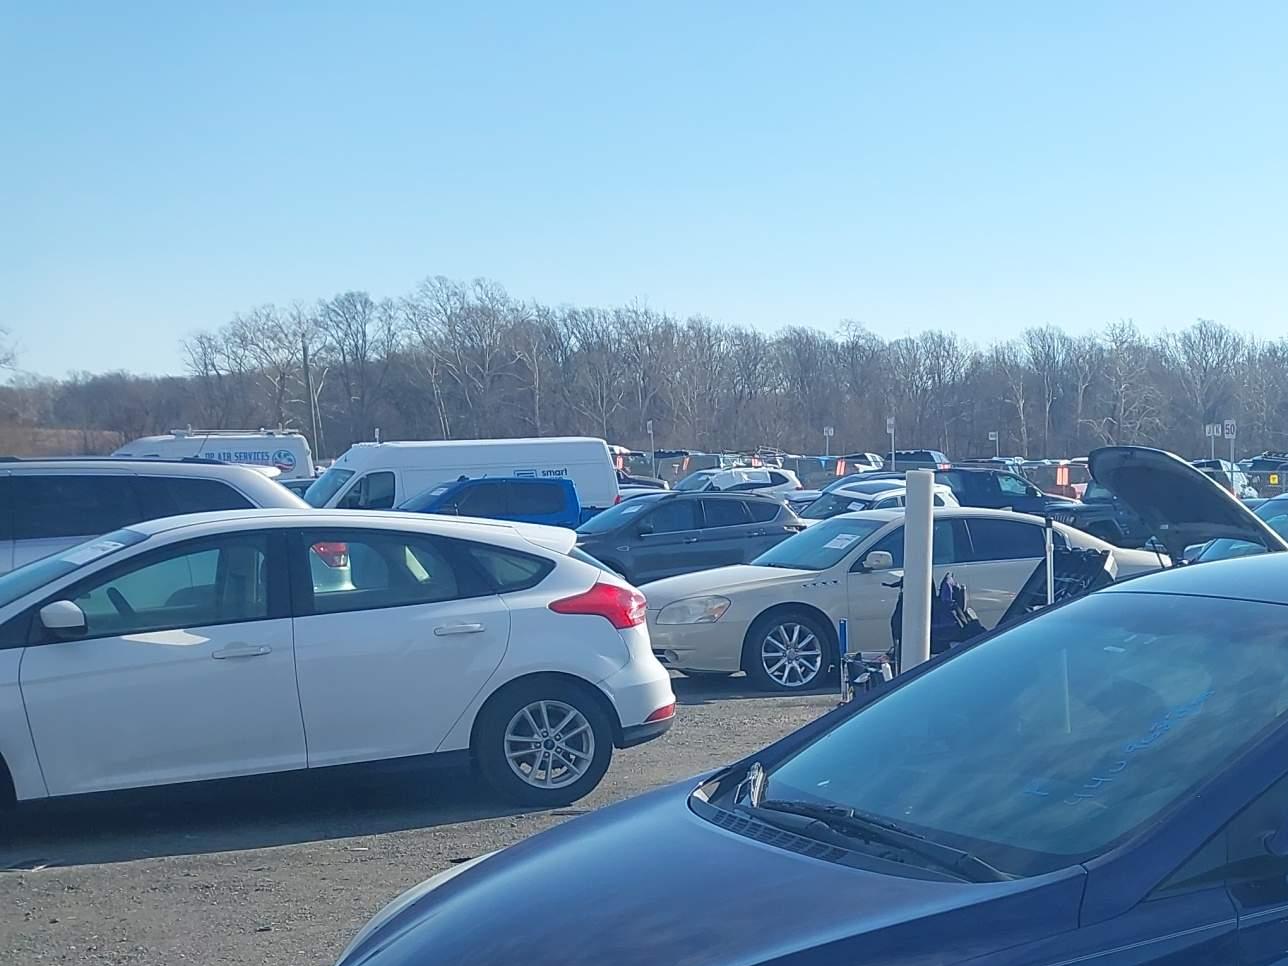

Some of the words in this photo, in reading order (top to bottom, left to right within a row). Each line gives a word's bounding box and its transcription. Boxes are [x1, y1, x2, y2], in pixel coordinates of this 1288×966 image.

[1225, 423, 1235, 435] 50
[218, 452, 232, 461] AIR
[234, 452, 269, 461] SERVICES
[541, 468, 567, 476] smart
